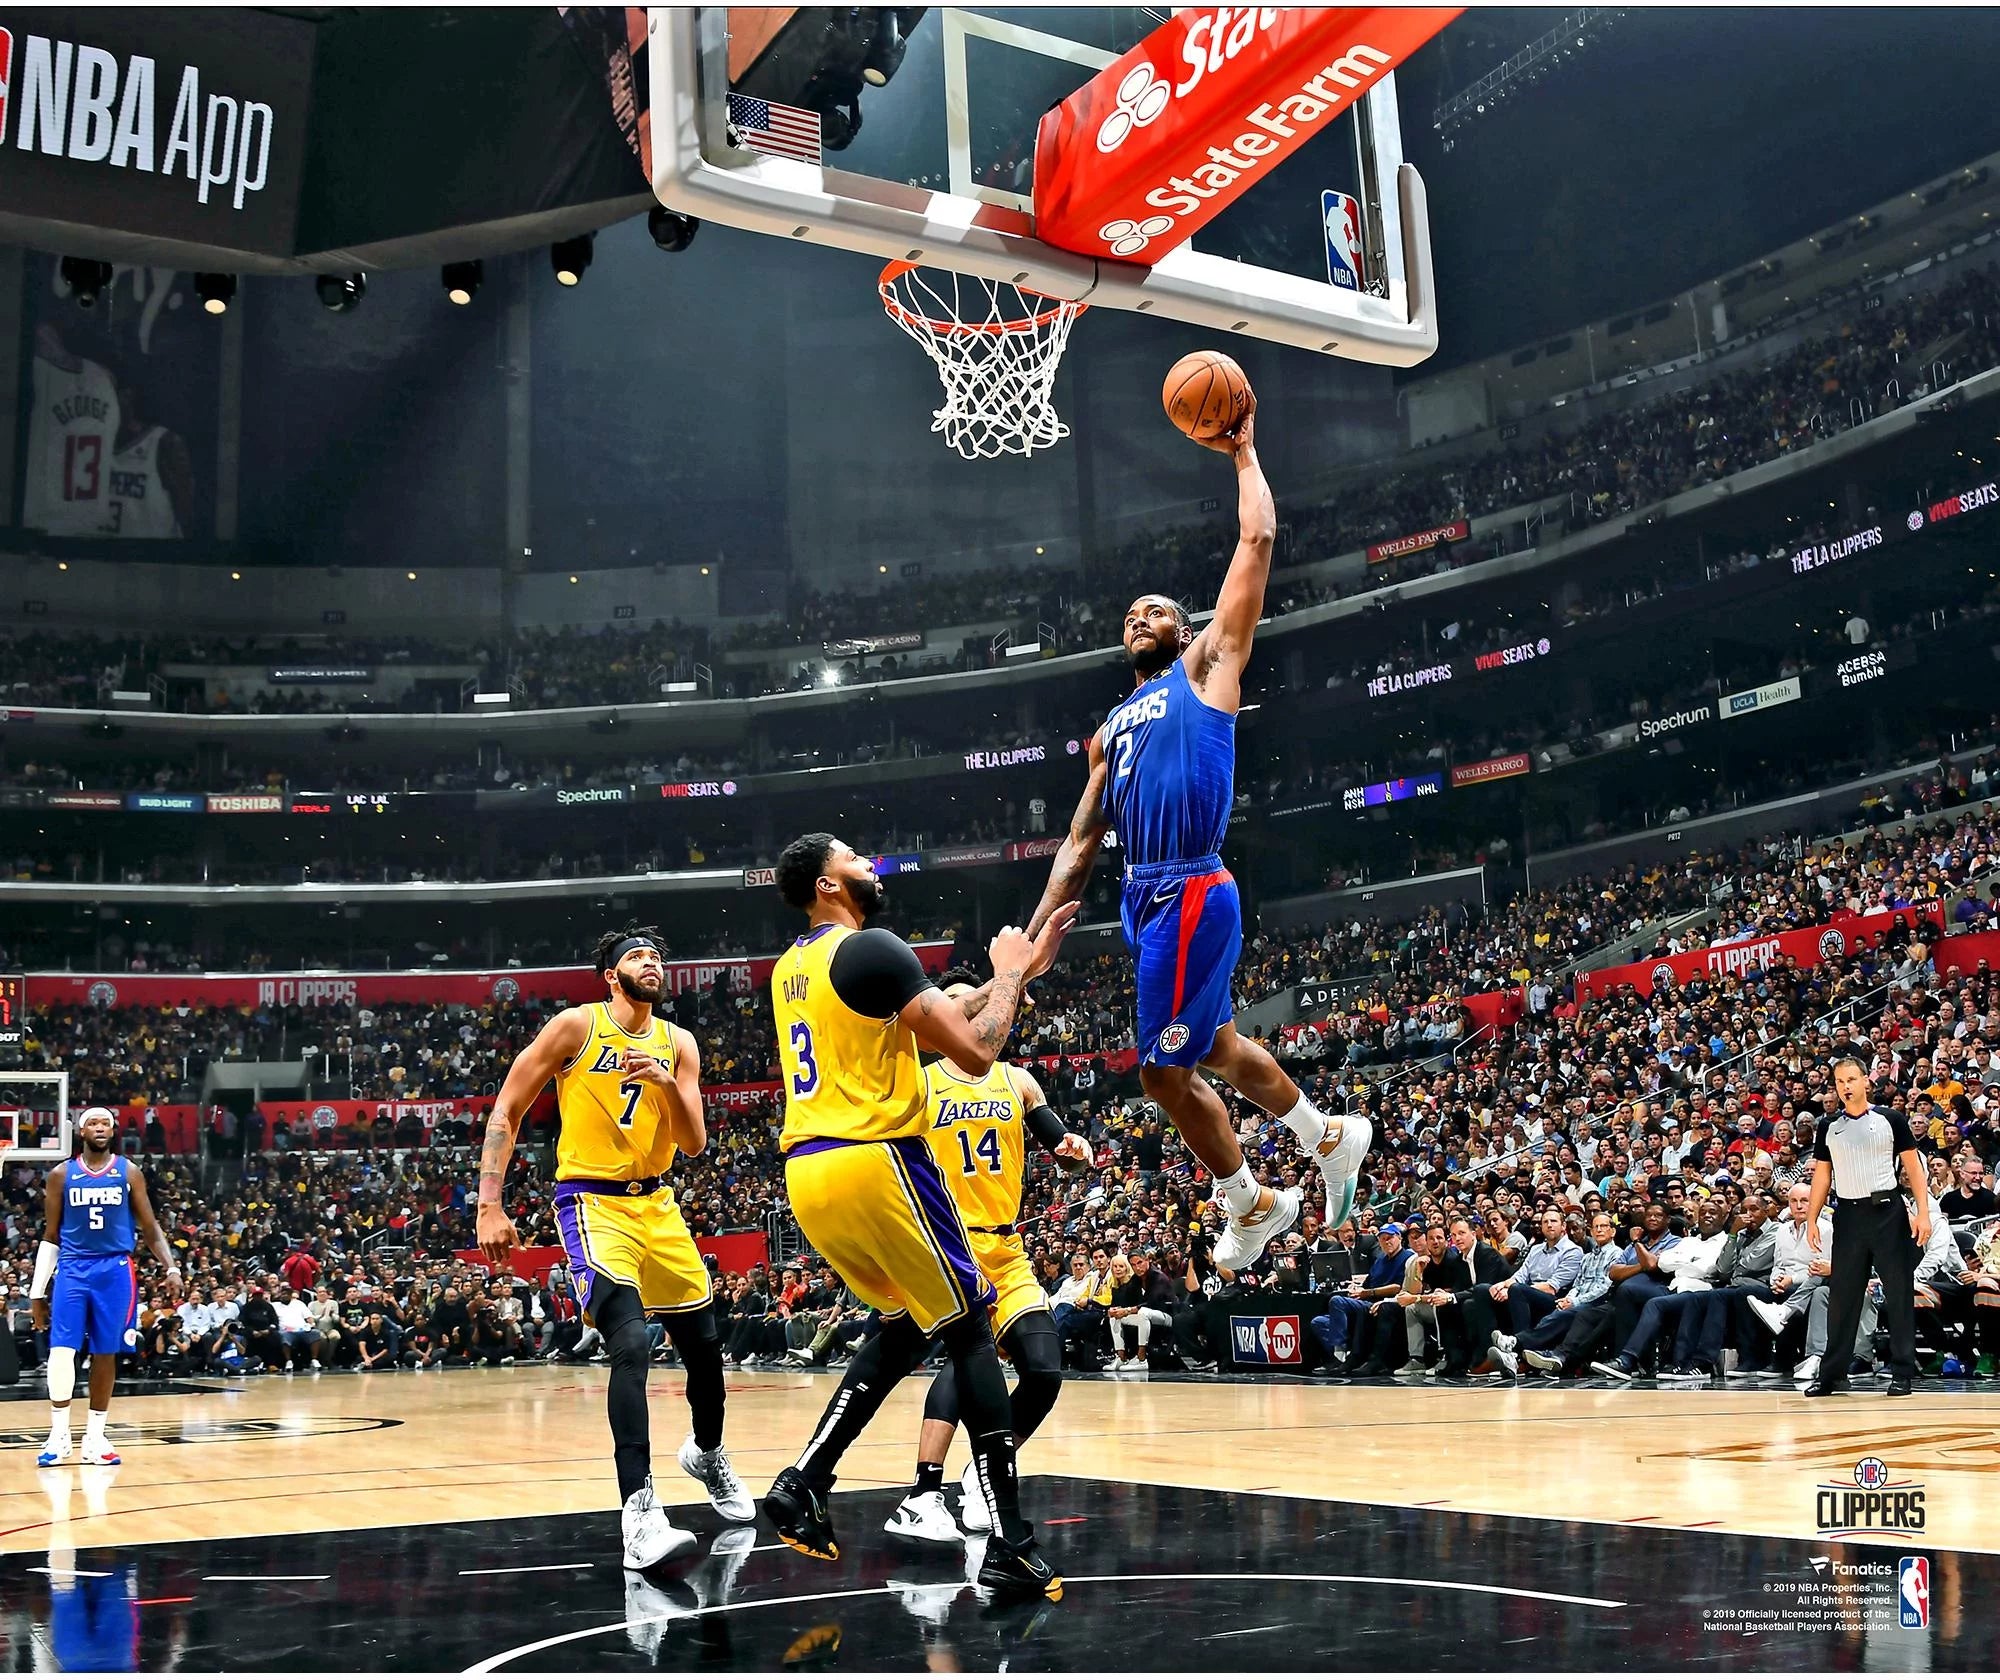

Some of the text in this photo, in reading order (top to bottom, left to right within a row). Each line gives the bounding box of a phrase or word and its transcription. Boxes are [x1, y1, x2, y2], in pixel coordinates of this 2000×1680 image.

[17, 35, 274, 210] NBA App
[1333, 267, 1353, 287] NBA
[52, 395, 110, 425] GEORGE
[64, 434, 102, 501] 13
[1377, 539, 1415, 556] WELLS
[1790, 526, 1883, 574] THE LA CLIPPERS
[1367, 663, 1452, 698] THE LA CLIPPERS
[1841, 665, 1885, 687] Bumble
[1733, 686, 1791, 708] UCLA Health
[1641, 705, 1710, 738] Spectrum
[964, 745, 1045, 770] THE LA CLIPPERS
[1116, 732, 1133, 778] 2
[1456, 758, 1524, 780] WELLS FARGO
[139, 798, 192, 808] BUD LIGHT
[347, 795, 367, 805] LAC
[557, 788, 622, 805] Spectrum
[1344, 787, 1364, 800] ANH
[1416, 783, 1438, 796] NHL
[209, 798, 281, 810] TOSHIBA
[1344, 797, 1365, 811] NSH
[900, 862, 920, 873] NHL
[951, 854, 976, 862] MANUEL
[978, 851, 1001, 859] CASINO
[783, 974, 809, 1003] DAVIS
[790, 1021, 818, 1098] 3
[619, 1082, 644, 1126] 7
[932, 1099, 1013, 1129] LAKERS
[957, 1128, 1001, 1174] 14
[69, 1186, 123, 1207] CLIPPERS
[89, 1206, 104, 1230] 5
[1236, 1326, 1295, 1353] NBA TNT
